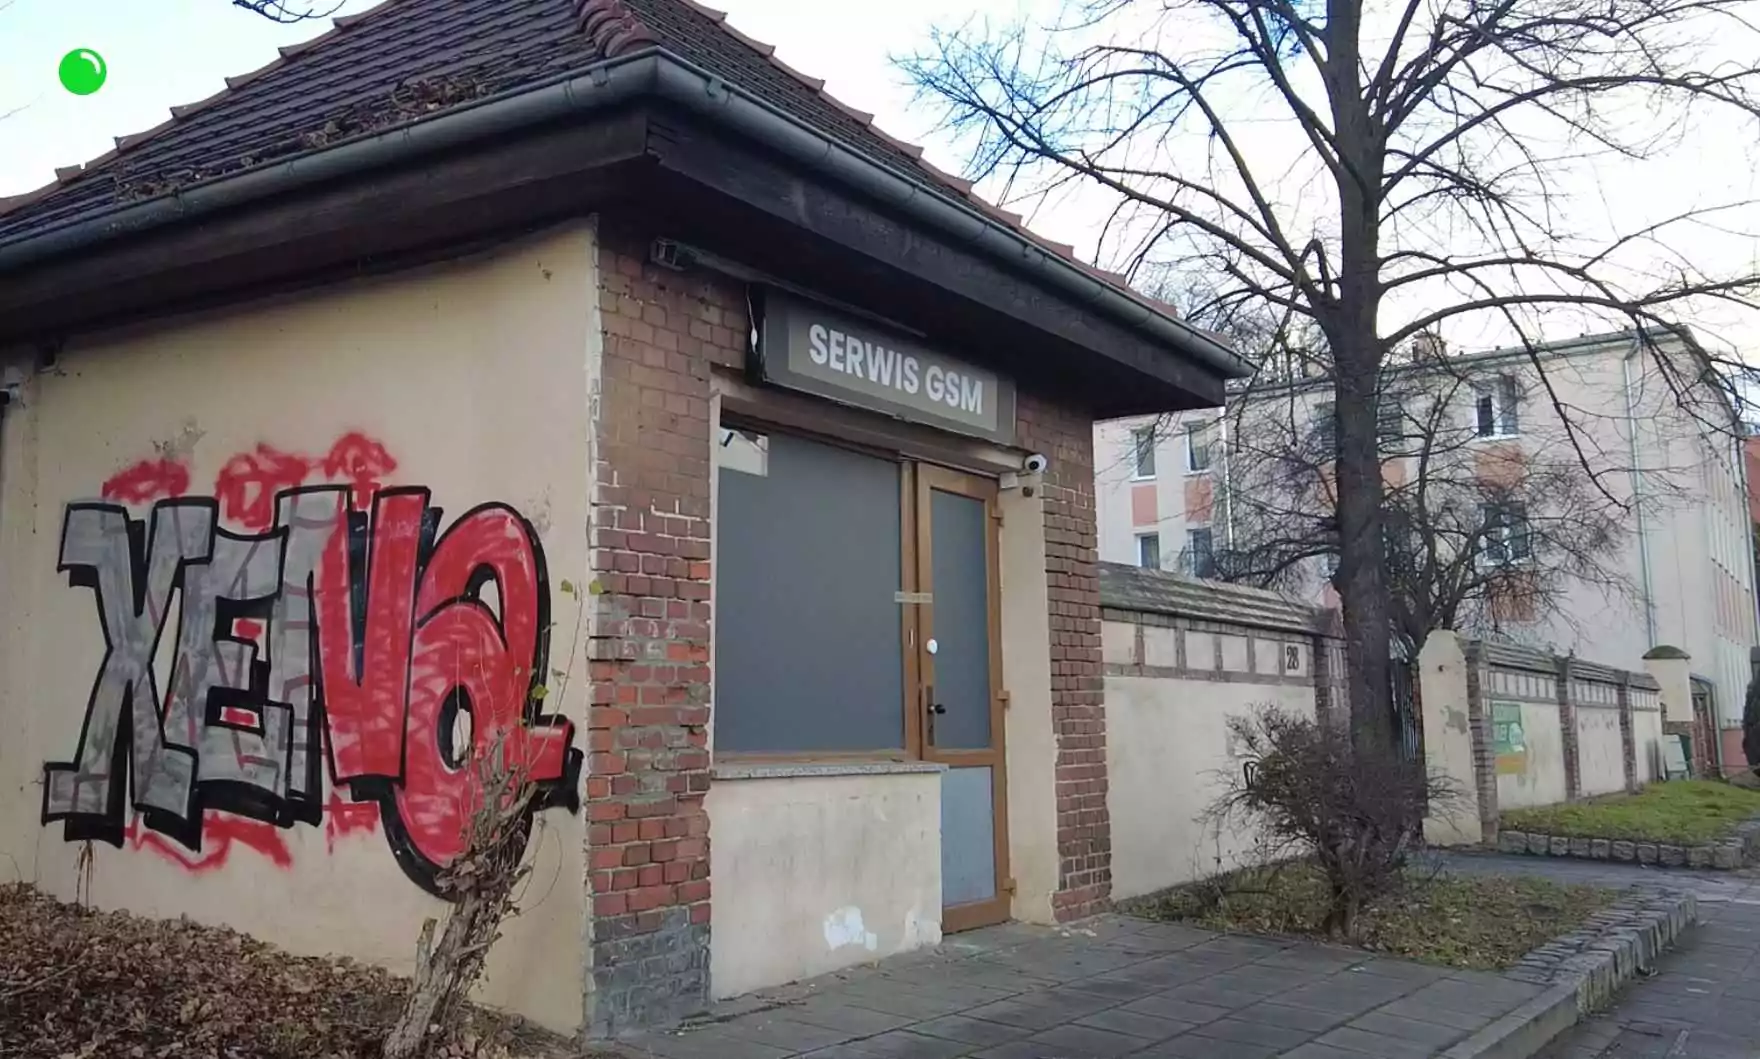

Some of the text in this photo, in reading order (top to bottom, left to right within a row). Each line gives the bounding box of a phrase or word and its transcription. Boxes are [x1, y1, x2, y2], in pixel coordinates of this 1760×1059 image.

[809, 324, 983, 415] SERWIS GSM
[1286, 645, 1300, 670] 28
